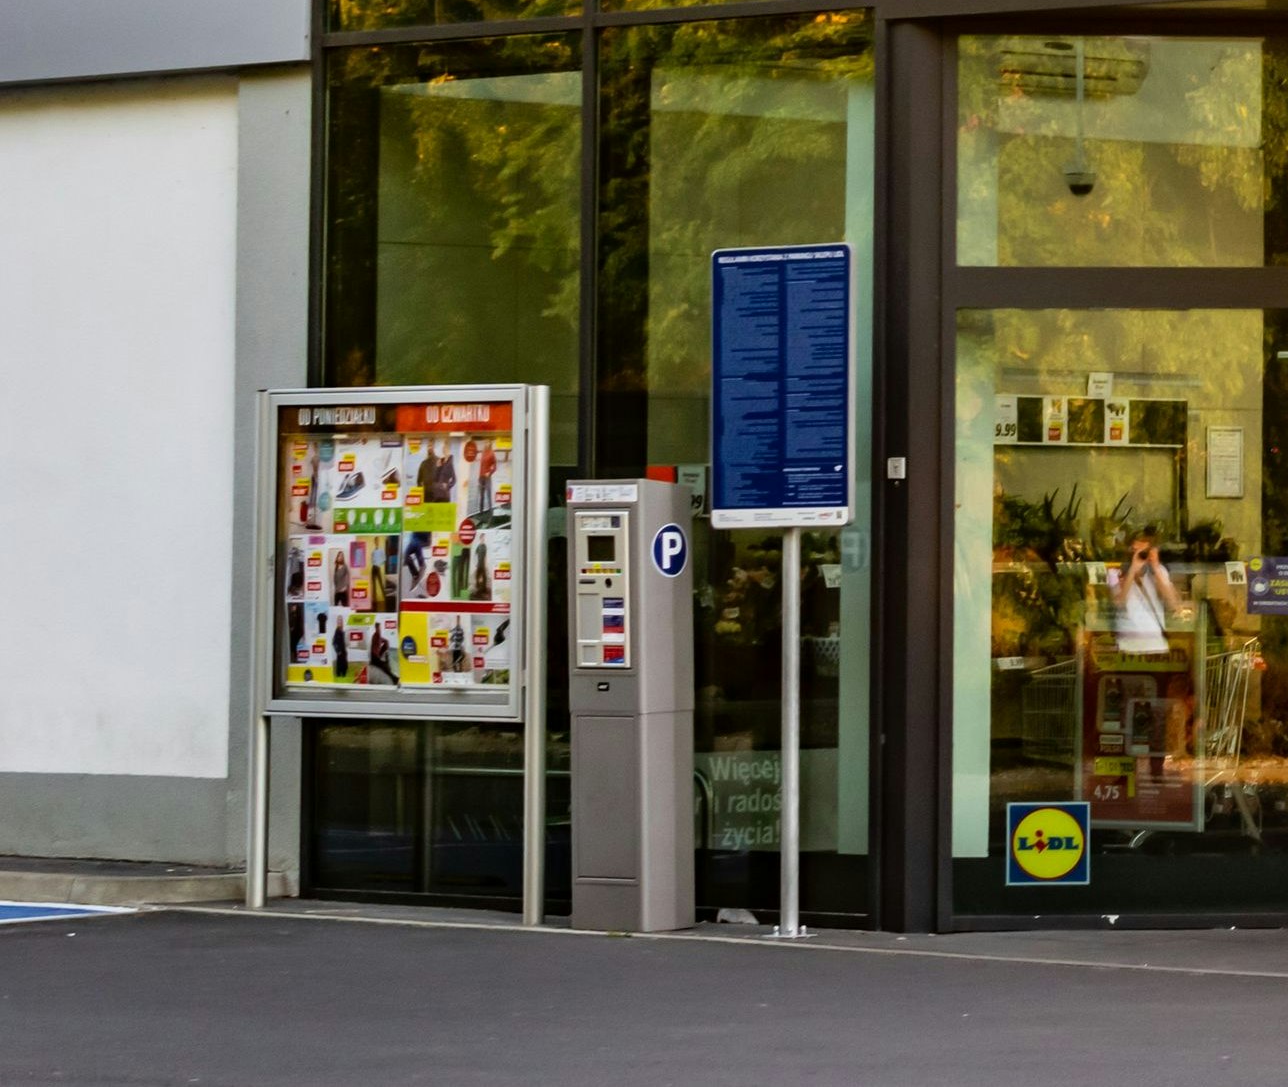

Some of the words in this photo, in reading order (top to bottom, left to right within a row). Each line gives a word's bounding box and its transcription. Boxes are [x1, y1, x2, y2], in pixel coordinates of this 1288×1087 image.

[298, 408, 311, 425] OD
[426, 405, 439, 423] OD
[662, 531, 683, 569] P
[709, 756, 780, 785] Więcej
[1094, 785, 1119, 801] 4,75
